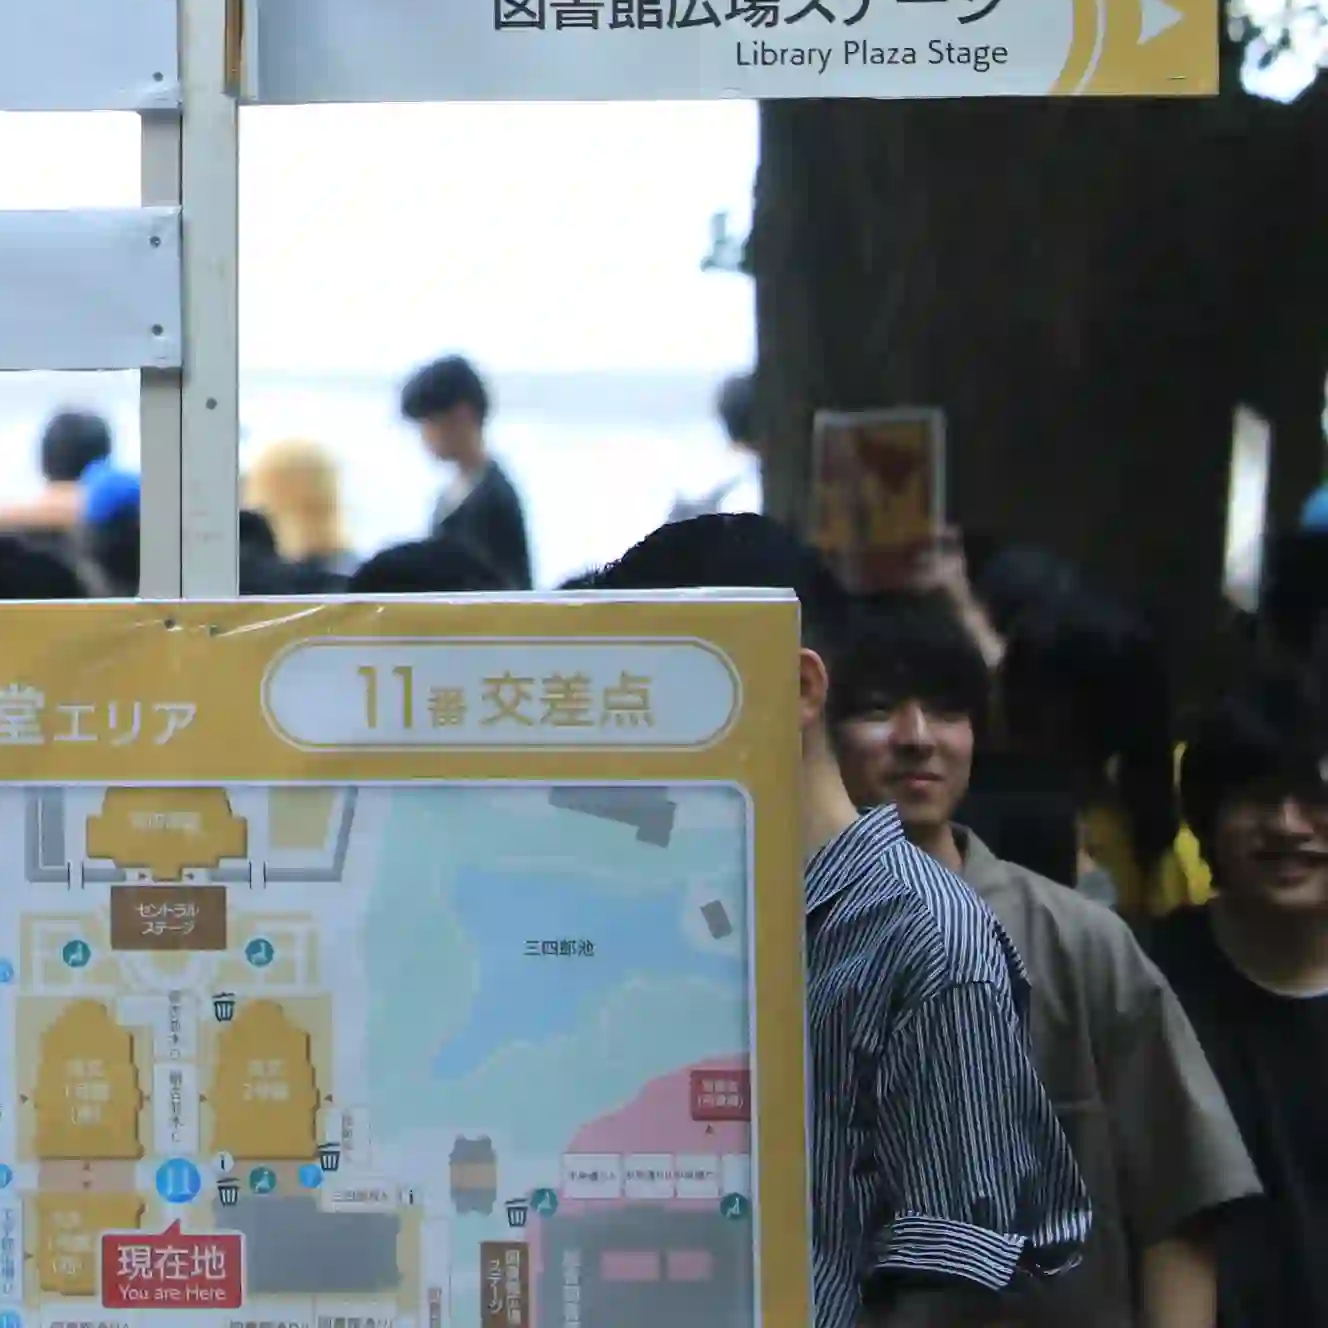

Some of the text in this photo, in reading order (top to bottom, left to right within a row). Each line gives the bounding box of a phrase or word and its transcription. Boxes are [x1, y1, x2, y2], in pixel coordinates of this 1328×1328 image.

[737, 39, 1008, 73] Library Plaza Stage
[135, 903, 200, 919] セントラル
[141, 920, 196, 936] ステージ
[117, 1244, 227, 1281] 現在地
[119, 1283, 227, 1302] You are Here
